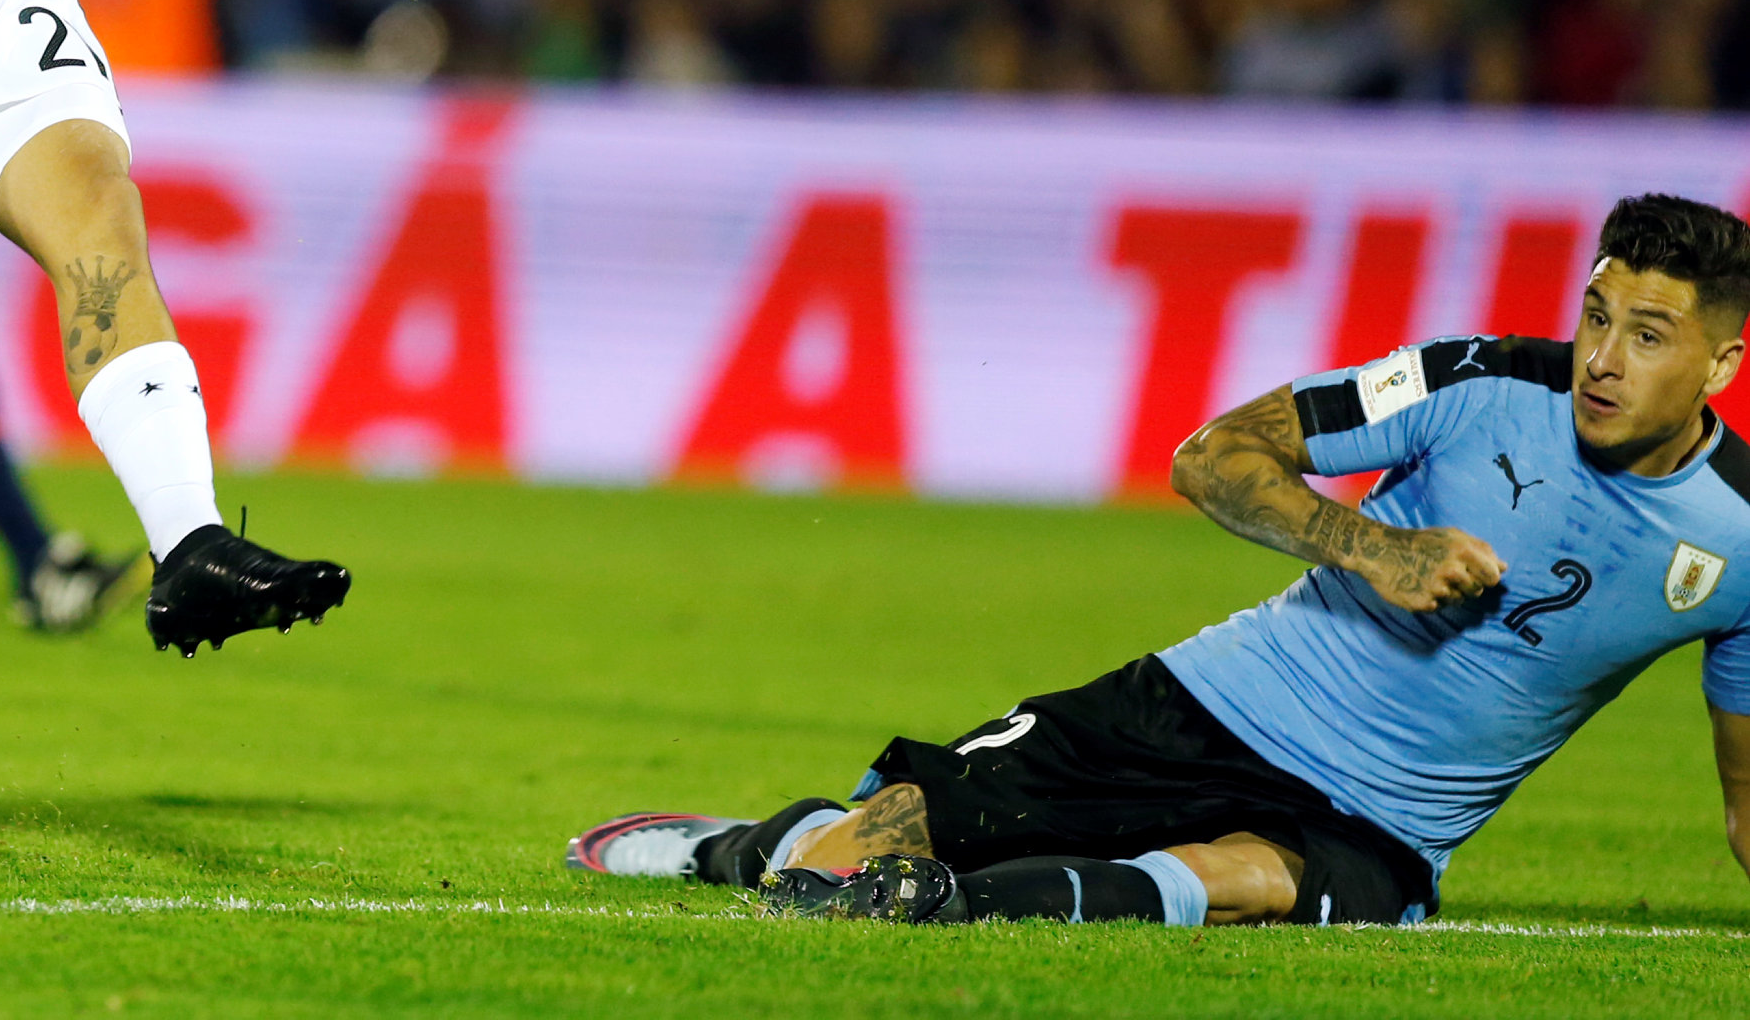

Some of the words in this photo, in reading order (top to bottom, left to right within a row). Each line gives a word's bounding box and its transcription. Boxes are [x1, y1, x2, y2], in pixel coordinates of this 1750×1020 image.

[18, 6, 108, 80] 2
[670, 185, 912, 487] A
[1502, 558, 1593, 648] 2
